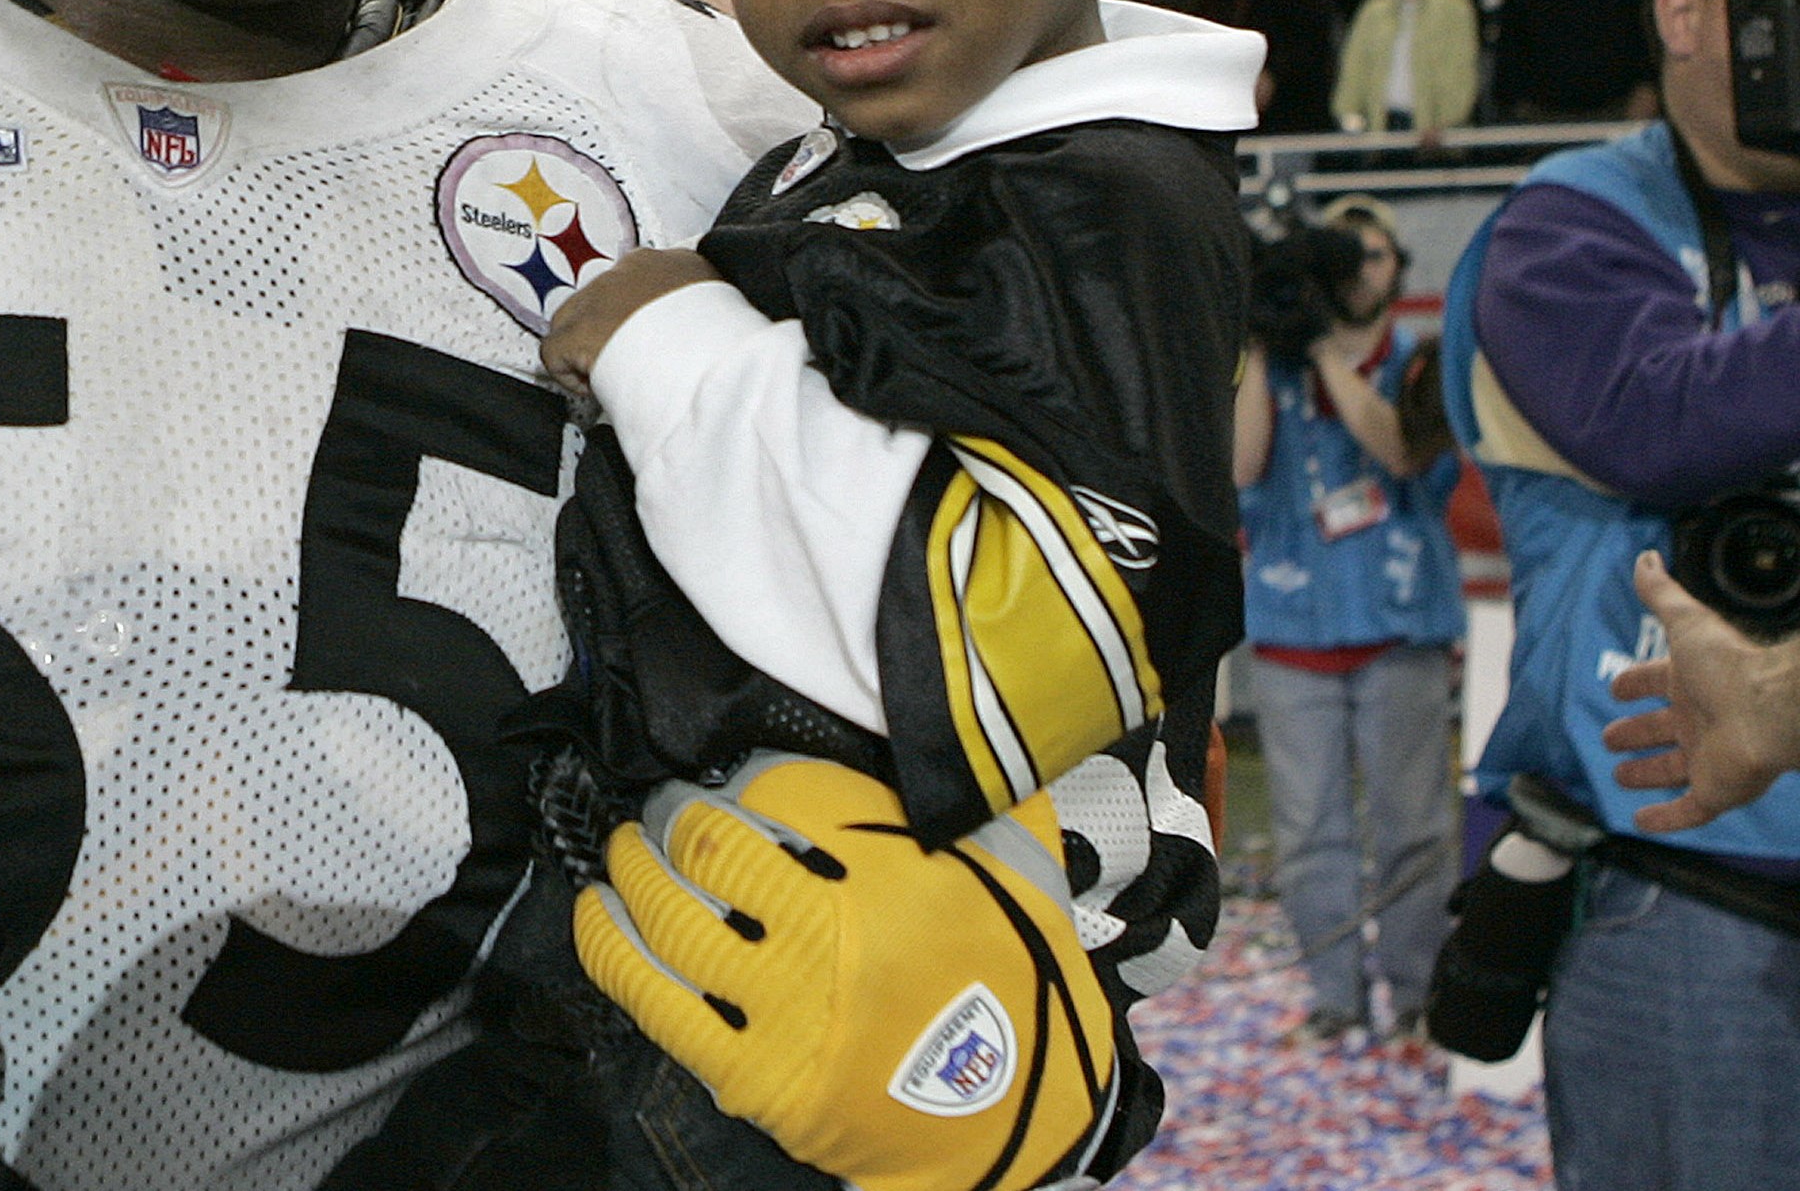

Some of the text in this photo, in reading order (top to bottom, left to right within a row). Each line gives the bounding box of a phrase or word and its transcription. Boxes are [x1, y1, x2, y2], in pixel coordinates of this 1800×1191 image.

[144, 128, 197, 166] NFL
[461, 202, 534, 240] Steelers
[910, 998, 985, 1089] EQUIPMENT
[951, 1051, 998, 1096] NFL
